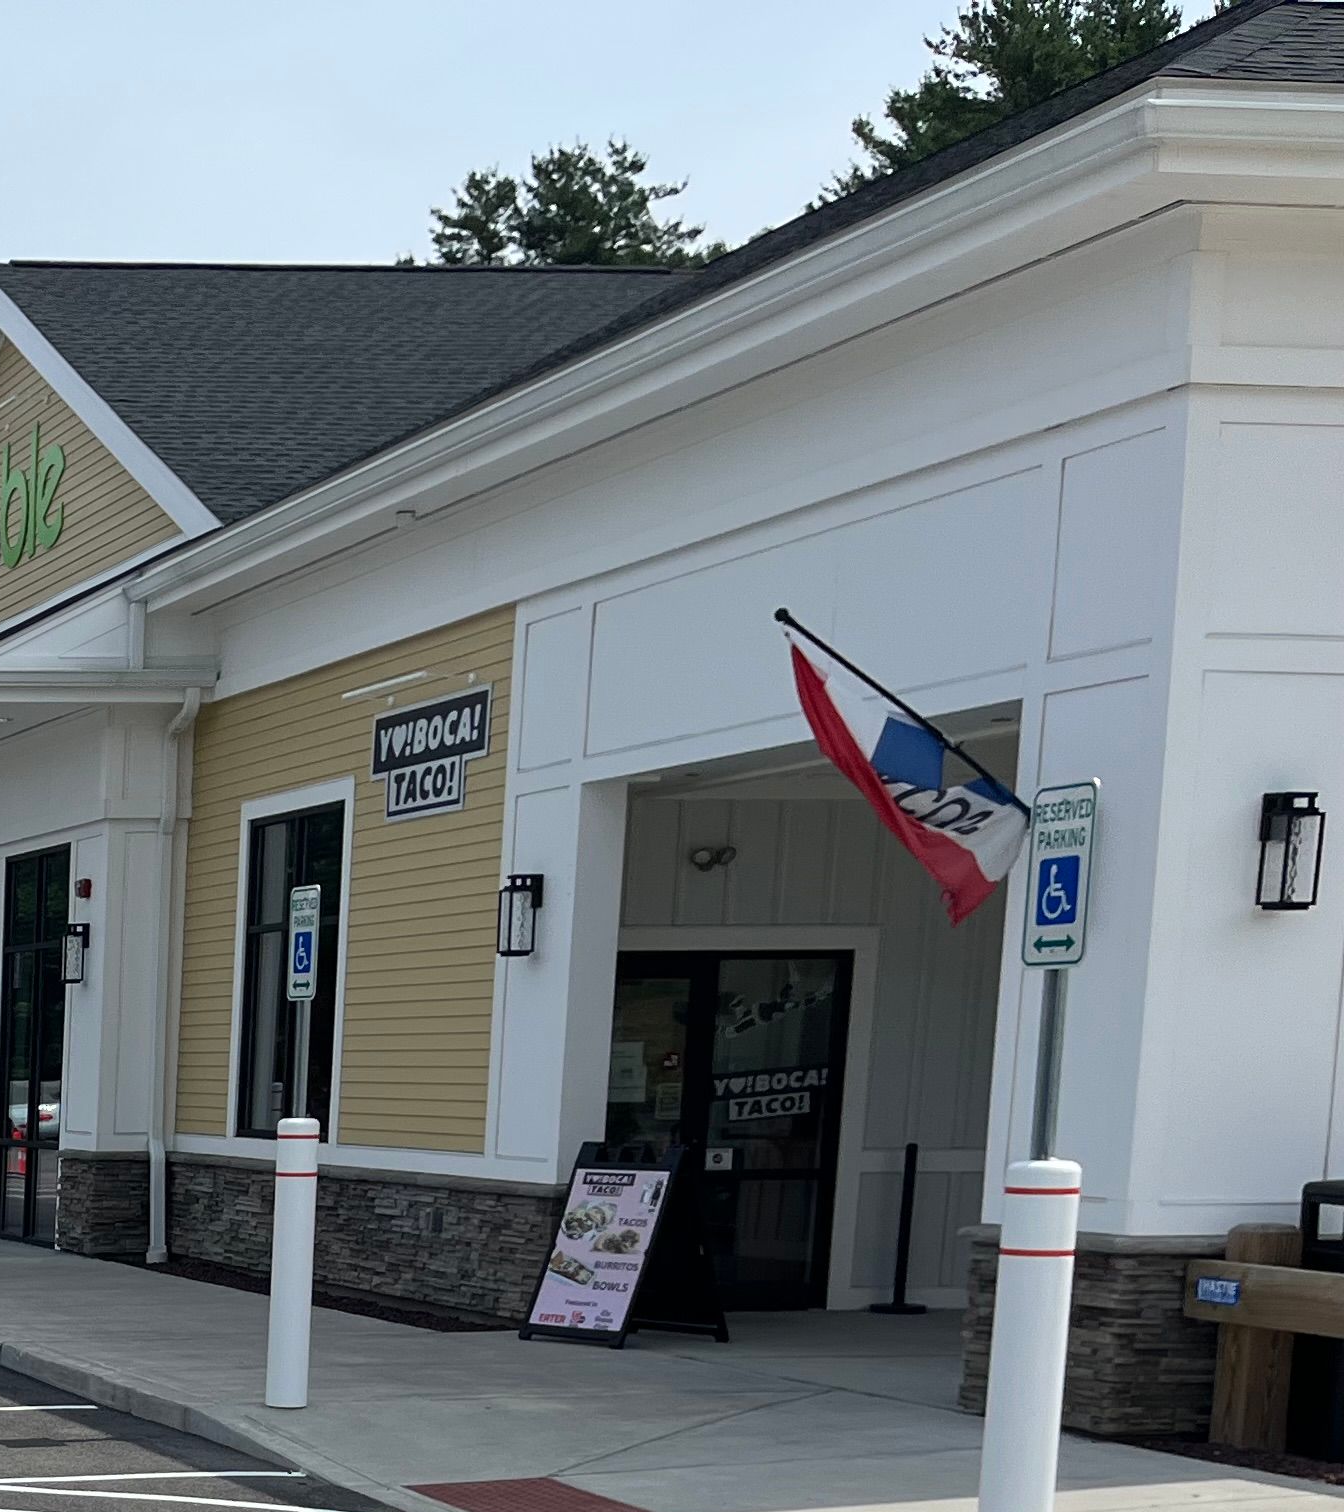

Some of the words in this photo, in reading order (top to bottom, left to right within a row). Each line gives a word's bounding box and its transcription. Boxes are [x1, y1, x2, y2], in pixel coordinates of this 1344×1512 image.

[394, 761, 456, 806] TACO!
[1035, 798, 1092, 823] RESERVED
[1038, 826, 1086, 851] PARKING
[734, 1095, 805, 1117] TACO!
